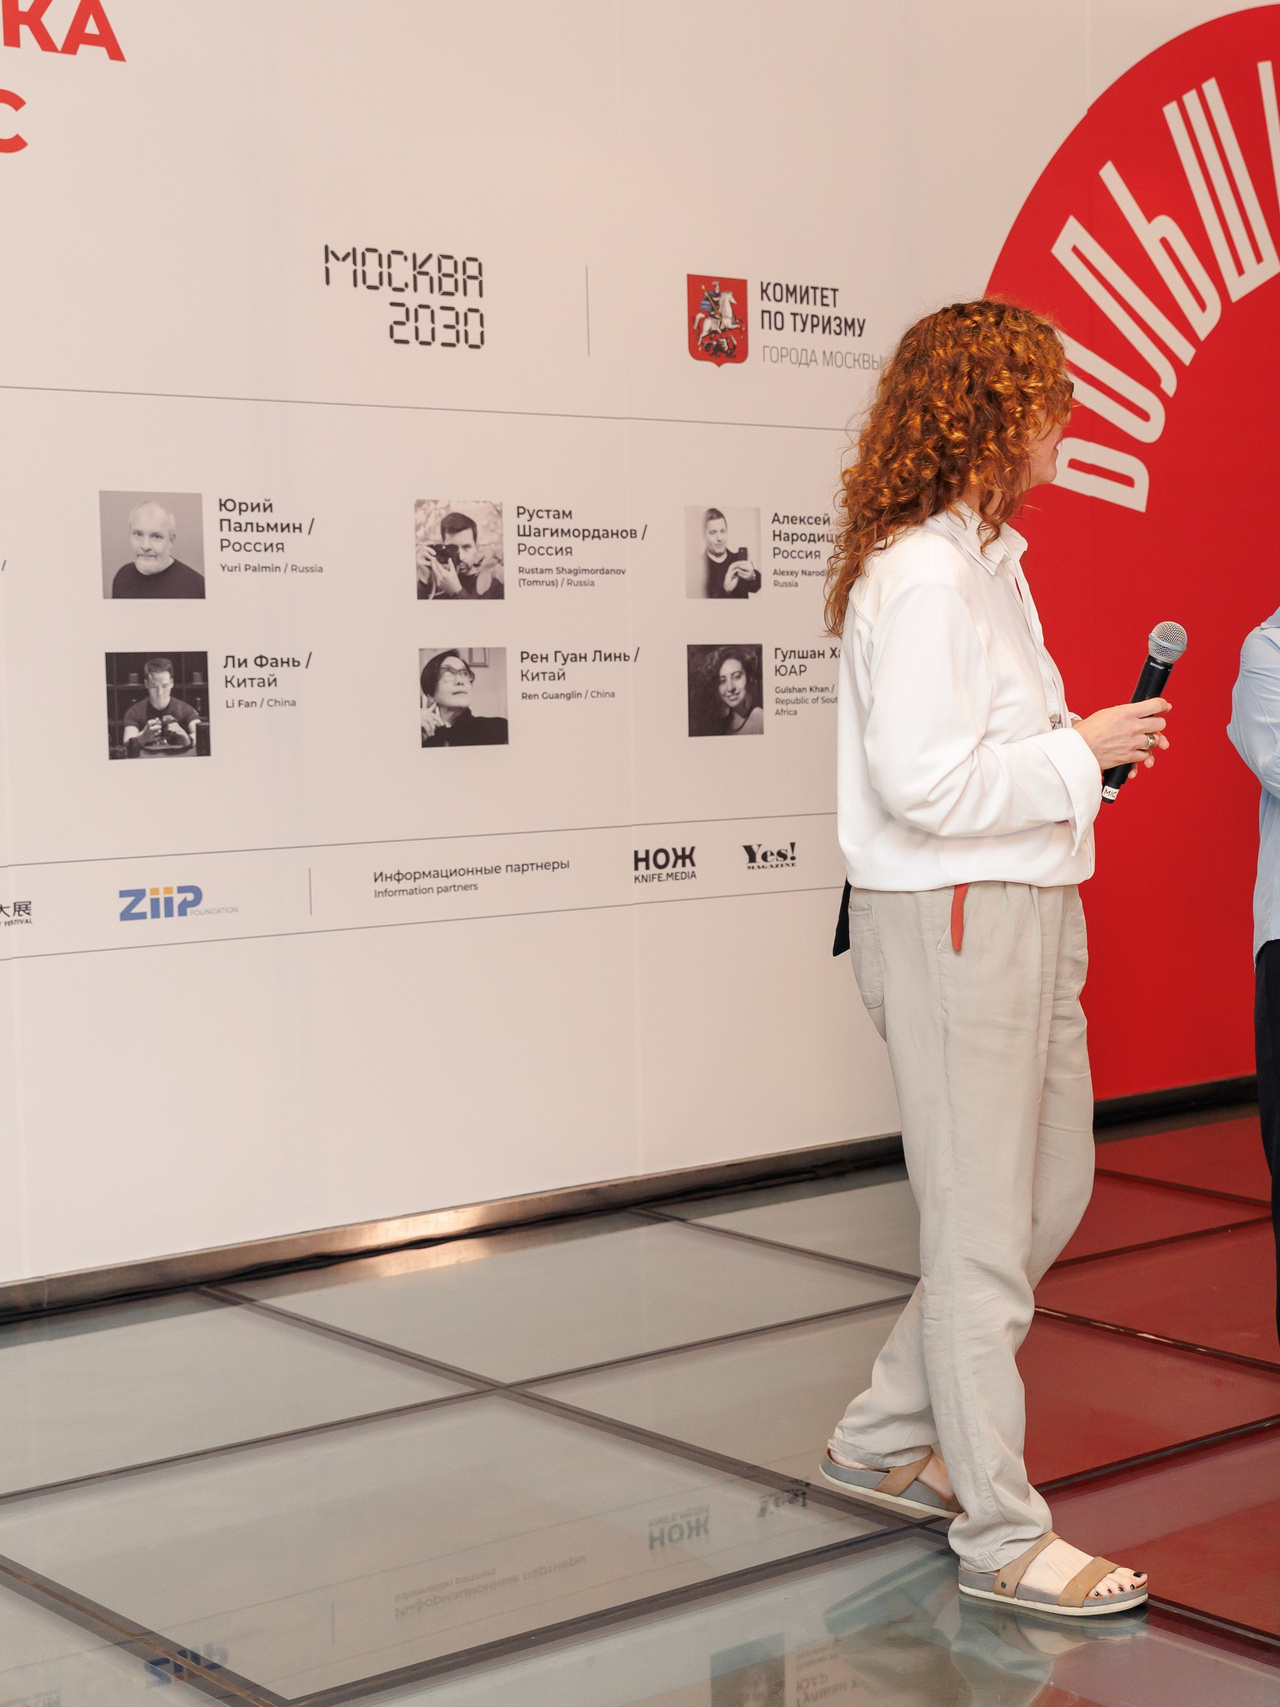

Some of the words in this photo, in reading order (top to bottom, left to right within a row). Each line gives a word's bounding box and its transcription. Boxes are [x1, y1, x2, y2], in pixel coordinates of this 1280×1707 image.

[324, 244, 483, 298] МОСКВА
[760, 281, 839, 308] КОМИТЕТ
[389, 302, 485, 349] 2030
[761, 310, 785, 331] ПО
[790, 312, 866, 338] ТУРИЗМУ
[762, 345, 818, 368] ГОРОДА
[822, 350, 882, 371] МОСКВЫ
[218, 498, 273, 515] Юрий
[516, 506, 573, 521] Рустам
[219, 518, 303, 533] Пальмин
[771, 513, 831, 526] Алексей
[517, 524, 638, 541] Шагиморданов
[772, 530, 838, 545] Народиц
[220, 538, 285, 553] Россия
[517, 543, 573, 556] Россия
[773, 547, 821, 559] Россия
[220, 563, 241, 573] Yuri
[244, 563, 281, 573] Palmin
[291, 564, 323, 573] Russia
[518, 566, 553, 575] Rustam
[556, 566, 626, 576] Shagimordanov
[772, 569, 799, 578] Alexey
[518, 578, 558, 588] (Tomrus)
[567, 578, 595, 587] Russia
[774, 580, 798, 588] Russia
[223, 655, 248, 669] Ли
[254, 654, 300, 668] Фань
[520, 651, 549, 663] Рен
[554, 650, 587, 666] Гуан
[592, 650, 631, 662] Линь
[774, 648, 825, 662] Гулшан
[520, 668, 566, 682] Китай
[774, 664, 807, 677] ЮАР
[224, 674, 277, 688] Китай
[521, 692, 539, 700] Ren
[541, 690, 582, 701] Guanglin
[590, 690, 615, 699] China
[775, 685, 807, 694] Gulshan
[809, 685, 829, 693] Khan
[226, 699, 235, 708] Li
[238, 699, 257, 708] Fan
[267, 698, 297, 708] China
[775, 696, 809, 706] Republic
[811, 696, 819, 704] of
[775, 708, 798, 717] Africa
[633, 846, 696, 871] НОЖ
[742, 842, 797, 864] Yes!
[373, 865, 502, 884] Информационные
[505, 860, 570, 875] партнеры
[747, 862, 798, 870] MAGAZINE
[633, 870, 697, 884] KNIFE.MEDIA
[374, 886, 434, 898] Information
[436, 882, 479, 895] partners
[190, 907, 239, 916] FOUNDATION
